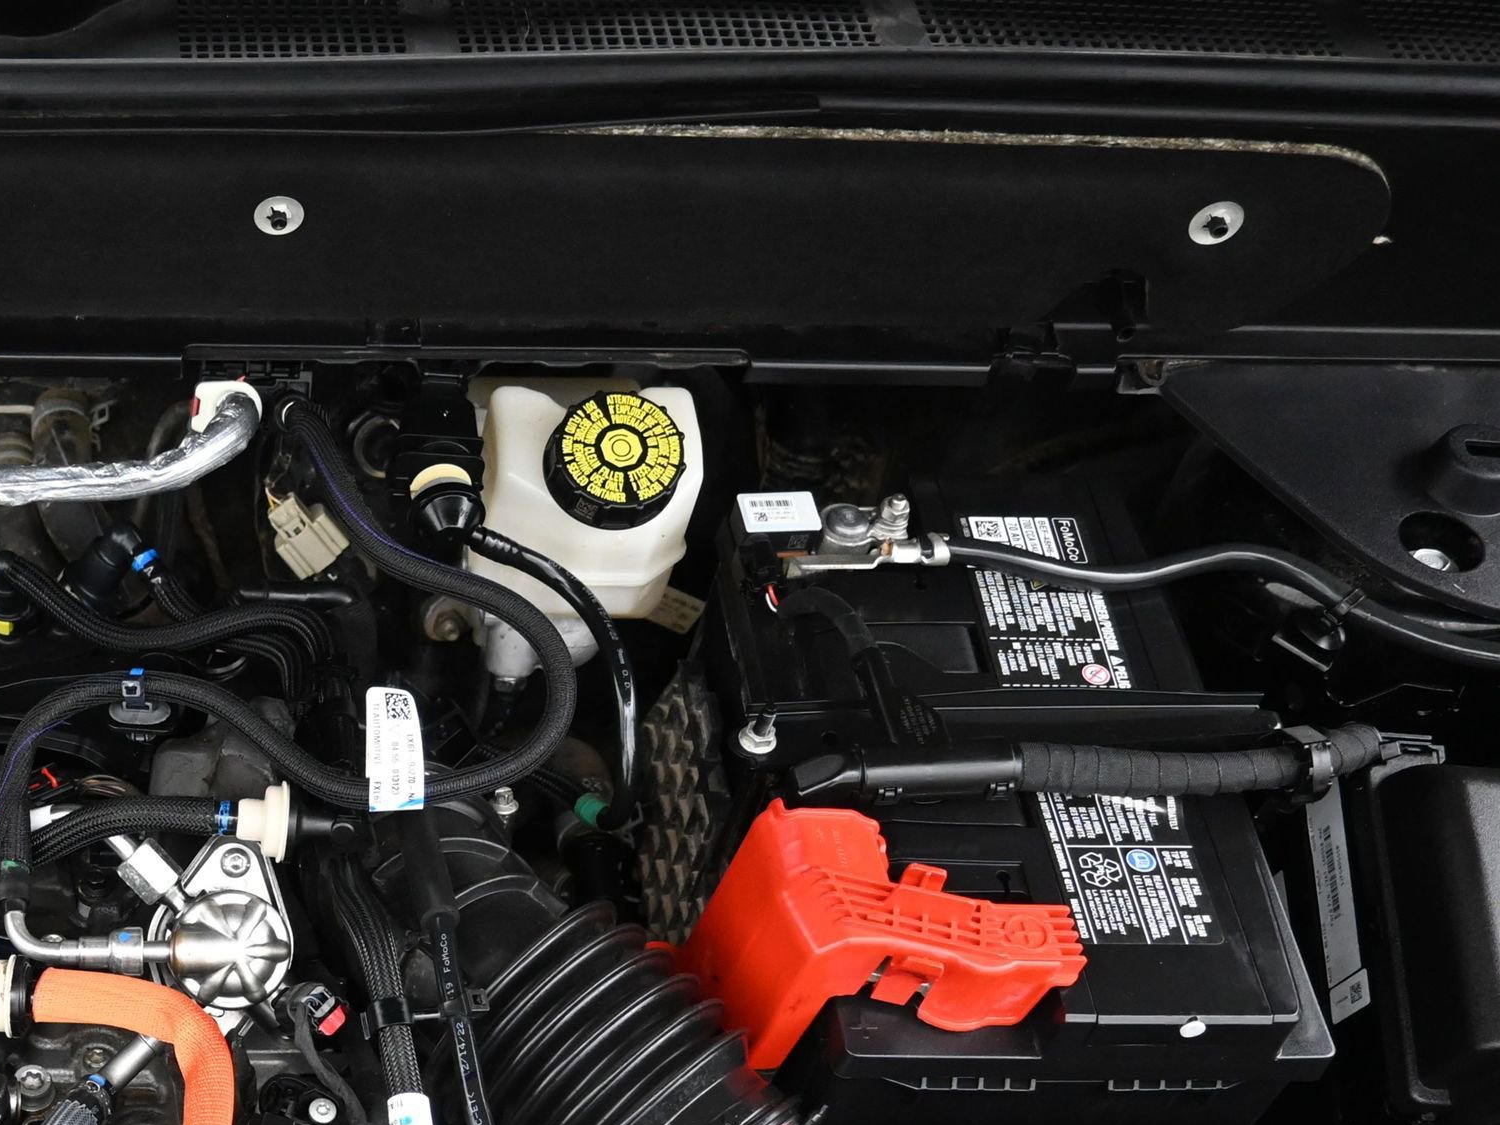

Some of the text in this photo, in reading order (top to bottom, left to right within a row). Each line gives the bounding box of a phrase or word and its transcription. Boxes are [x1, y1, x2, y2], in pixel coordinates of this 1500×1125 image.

[584, 447, 601, 469] CLEAN
[587, 483, 626, 503] CONTAINER
[1007, 523, 1021, 541] 70 Ah
[1057, 520, 1081, 560] FoMoCo
[1090, 594, 1119, 649] ANGER/POISON
[1057, 810, 1068, 820] LOS
[1146, 813, 1159, 826] FAST.
[1169, 850, 1180, 858] TIP
[1044, 819, 1059, 842] COMPANY,
[1063, 878, 1075, 892] 48121
[1075, 919, 1090, 938] MEXICO
[1190, 885, 1202, 895] PAS
[1108, 897, 1122, 921] BATTERIE
[1116, 897, 1131, 924] RECYCLED
[1121, 889, 1134, 912] BATTERY
[1157, 889, 1178, 929] INSTRUCTIONS.
[1087, 900, 1102, 929] RECICLADA
[1149, 897, 1171, 937] INSTRUCTIONS.
[440, 932, 451, 973] FoMoCo
